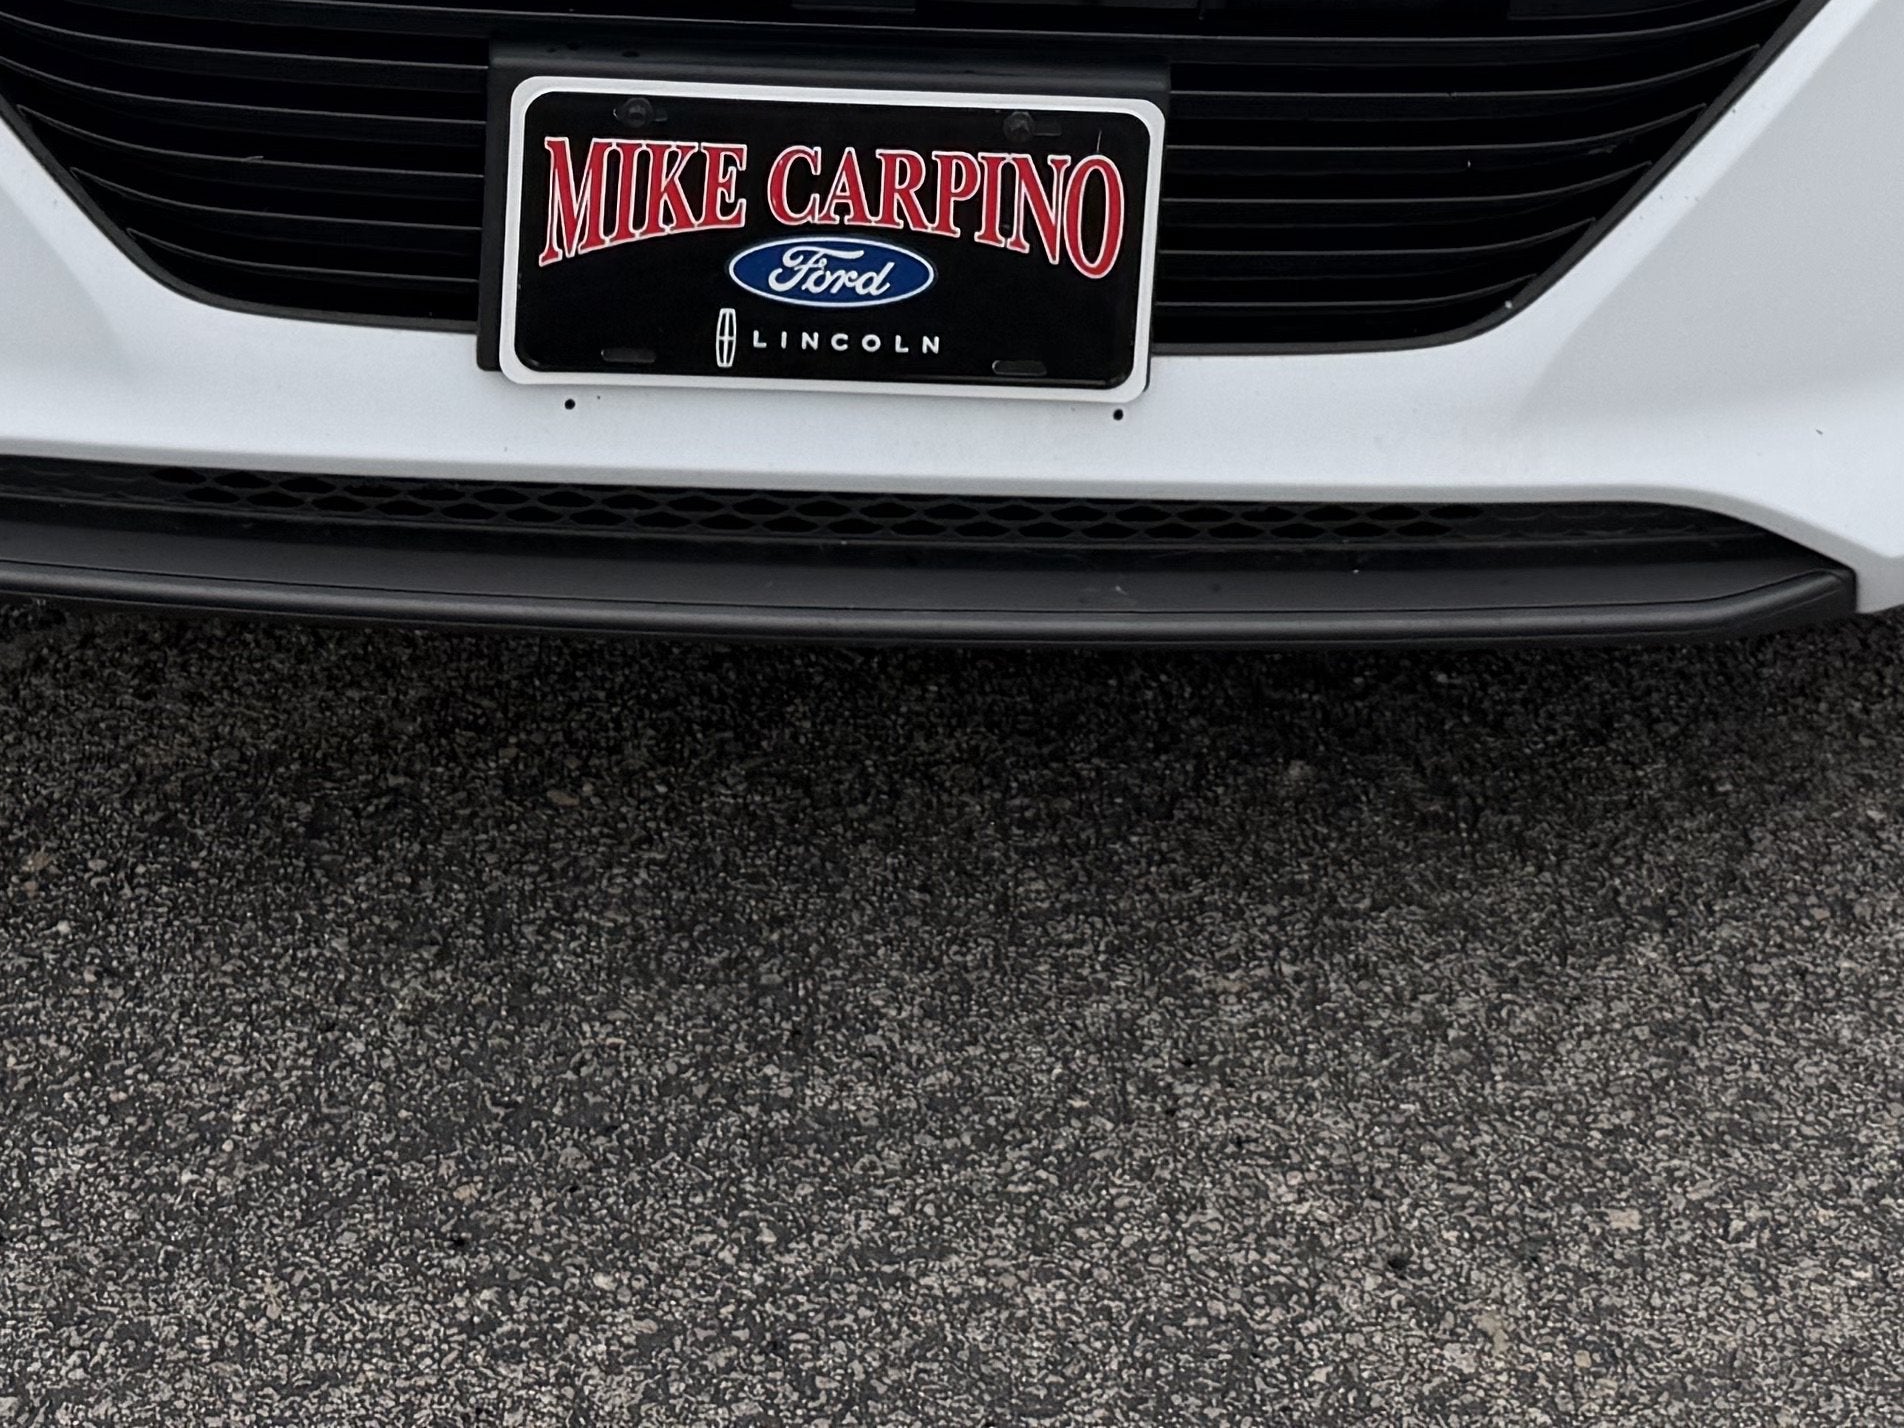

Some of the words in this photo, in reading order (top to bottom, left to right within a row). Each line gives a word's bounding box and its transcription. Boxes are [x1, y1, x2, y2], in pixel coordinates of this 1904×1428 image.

[538, 136, 748, 267] MIKE
[766, 145, 1125, 279] CARPINO
[768, 245, 891, 297] Ford
[752, 329, 940, 354] LINCOLN
